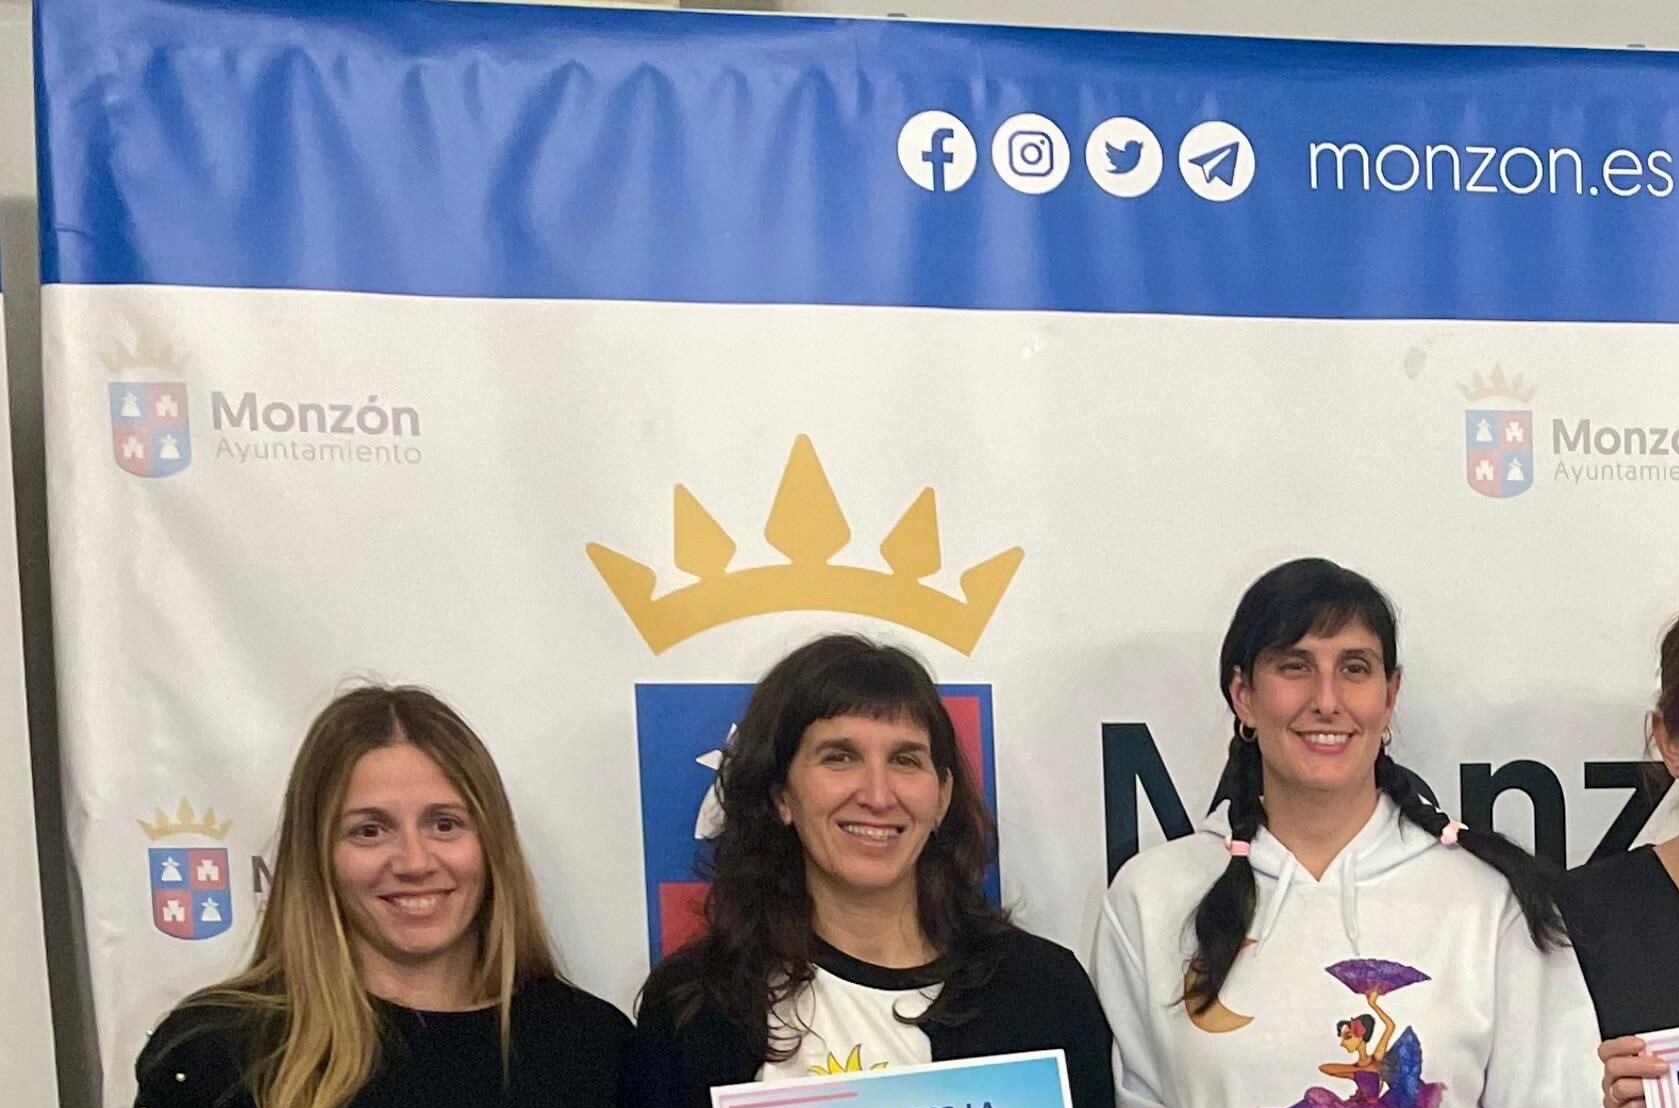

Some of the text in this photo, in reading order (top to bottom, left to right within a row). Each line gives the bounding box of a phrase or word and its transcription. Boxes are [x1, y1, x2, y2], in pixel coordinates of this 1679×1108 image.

[1308, 139, 1674, 198] monzon.es
[211, 391, 420, 436] Monzón
[216, 437, 421, 465] Ayuntamiento
